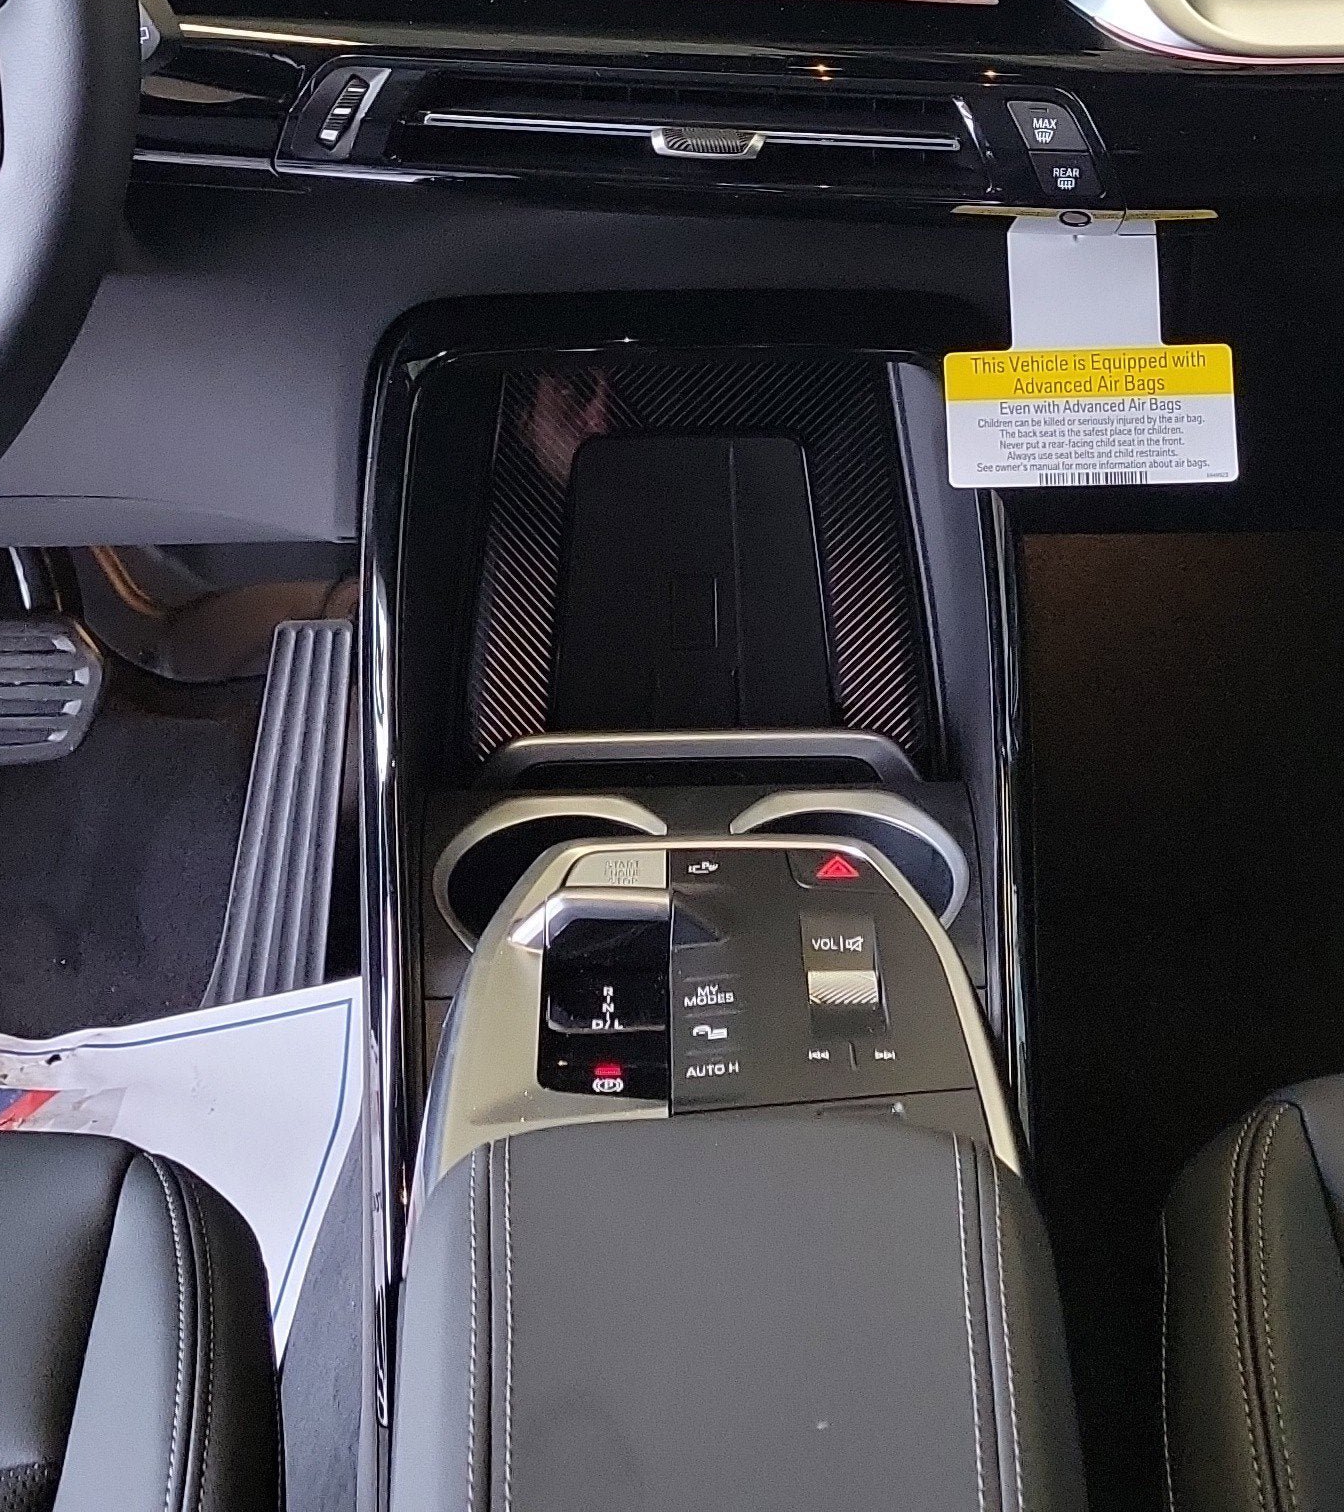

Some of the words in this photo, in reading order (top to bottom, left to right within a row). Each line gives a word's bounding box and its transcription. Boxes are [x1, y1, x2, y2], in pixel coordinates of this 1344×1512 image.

[1033, 118, 1057, 129] MAX
[1053, 168, 1080, 178] REAR
[970, 356, 1005, 374] This
[1009, 354, 1068, 373] Vehicle
[1073, 354, 1086, 371] is
[1091, 351, 1168, 373] Equipped
[1172, 350, 1206, 368] with
[1014, 376, 1092, 395] Advanced
[1097, 375, 1120, 392] Air
[1124, 374, 1165, 395] Bags
[1000, 401, 1030, 415] Even
[1032, 400, 1060, 414] with
[1063, 398, 1125, 413] Advanced
[1128, 397, 1147, 412] Air
[1149, 397, 1182, 414] Bags
[977, 418, 1013, 428] Children
[1015, 419, 1030, 428] can
[1031, 418, 1042, 427] be
[1043, 417, 1066, 427] killed
[1077, 416, 1115, 427] seriously
[1116, 415, 1145, 427] injured
[1146, 415, 1157, 426] by
[1158, 414, 1173, 424] the
[1174, 414, 1185, 423] air
[1186, 414, 1205, 425] bag.
[999, 429, 1016, 438] The
[1017, 429, 1039, 438] back
[1039, 429, 1057, 438] seat
[1058, 429, 1066, 437] is
[1067, 428, 1081, 437] the
[1082, 427, 1108, 437] safest
[1109, 427, 1132, 438] place
[1134, 427, 1146, 436] for
[1147, 426, 1184, 435] children.
[999, 440, 1024, 450] Never
[1025, 440, 1040, 450] put
[1041, 441, 1047, 449] a
[1047, 439, 1094, 450] rear-facing
[1096, 438, 1116, 448] child
[1117, 439, 1136, 447] seat
[1136, 438, 1145, 447] in
[1146, 437, 1160, 446] the
[1162, 437, 1185, 446] front.
[1007, 451, 1037, 462] Always
[1037, 452, 1053, 460] use
[1054, 451, 1073, 460] seat
[1074, 450, 1095, 459] belts
[1096, 449, 1112, 459] and
[1113, 448, 1134, 458] child
[1136, 448, 1178, 457] restraints.
[976, 462, 994, 473] See
[995, 462, 1028, 472] owner's
[1029, 461, 1060, 471] manual
[1061, 460, 1074, 471] for
[1075, 461, 1097, 470] more
[1098, 459, 1147, 469] information
[1148, 459, 1173, 469] about
[1174, 459, 1186, 468] air
[1186, 458, 1210, 469] bags.
[811, 936, 839, 951] VOL
[697, 984, 719, 996] MY
[684, 991, 734, 1007] MODES
[602, 1002, 615, 1013] N
[686, 1062, 726, 1078] AUTO
[728, 1060, 739, 1074] H
